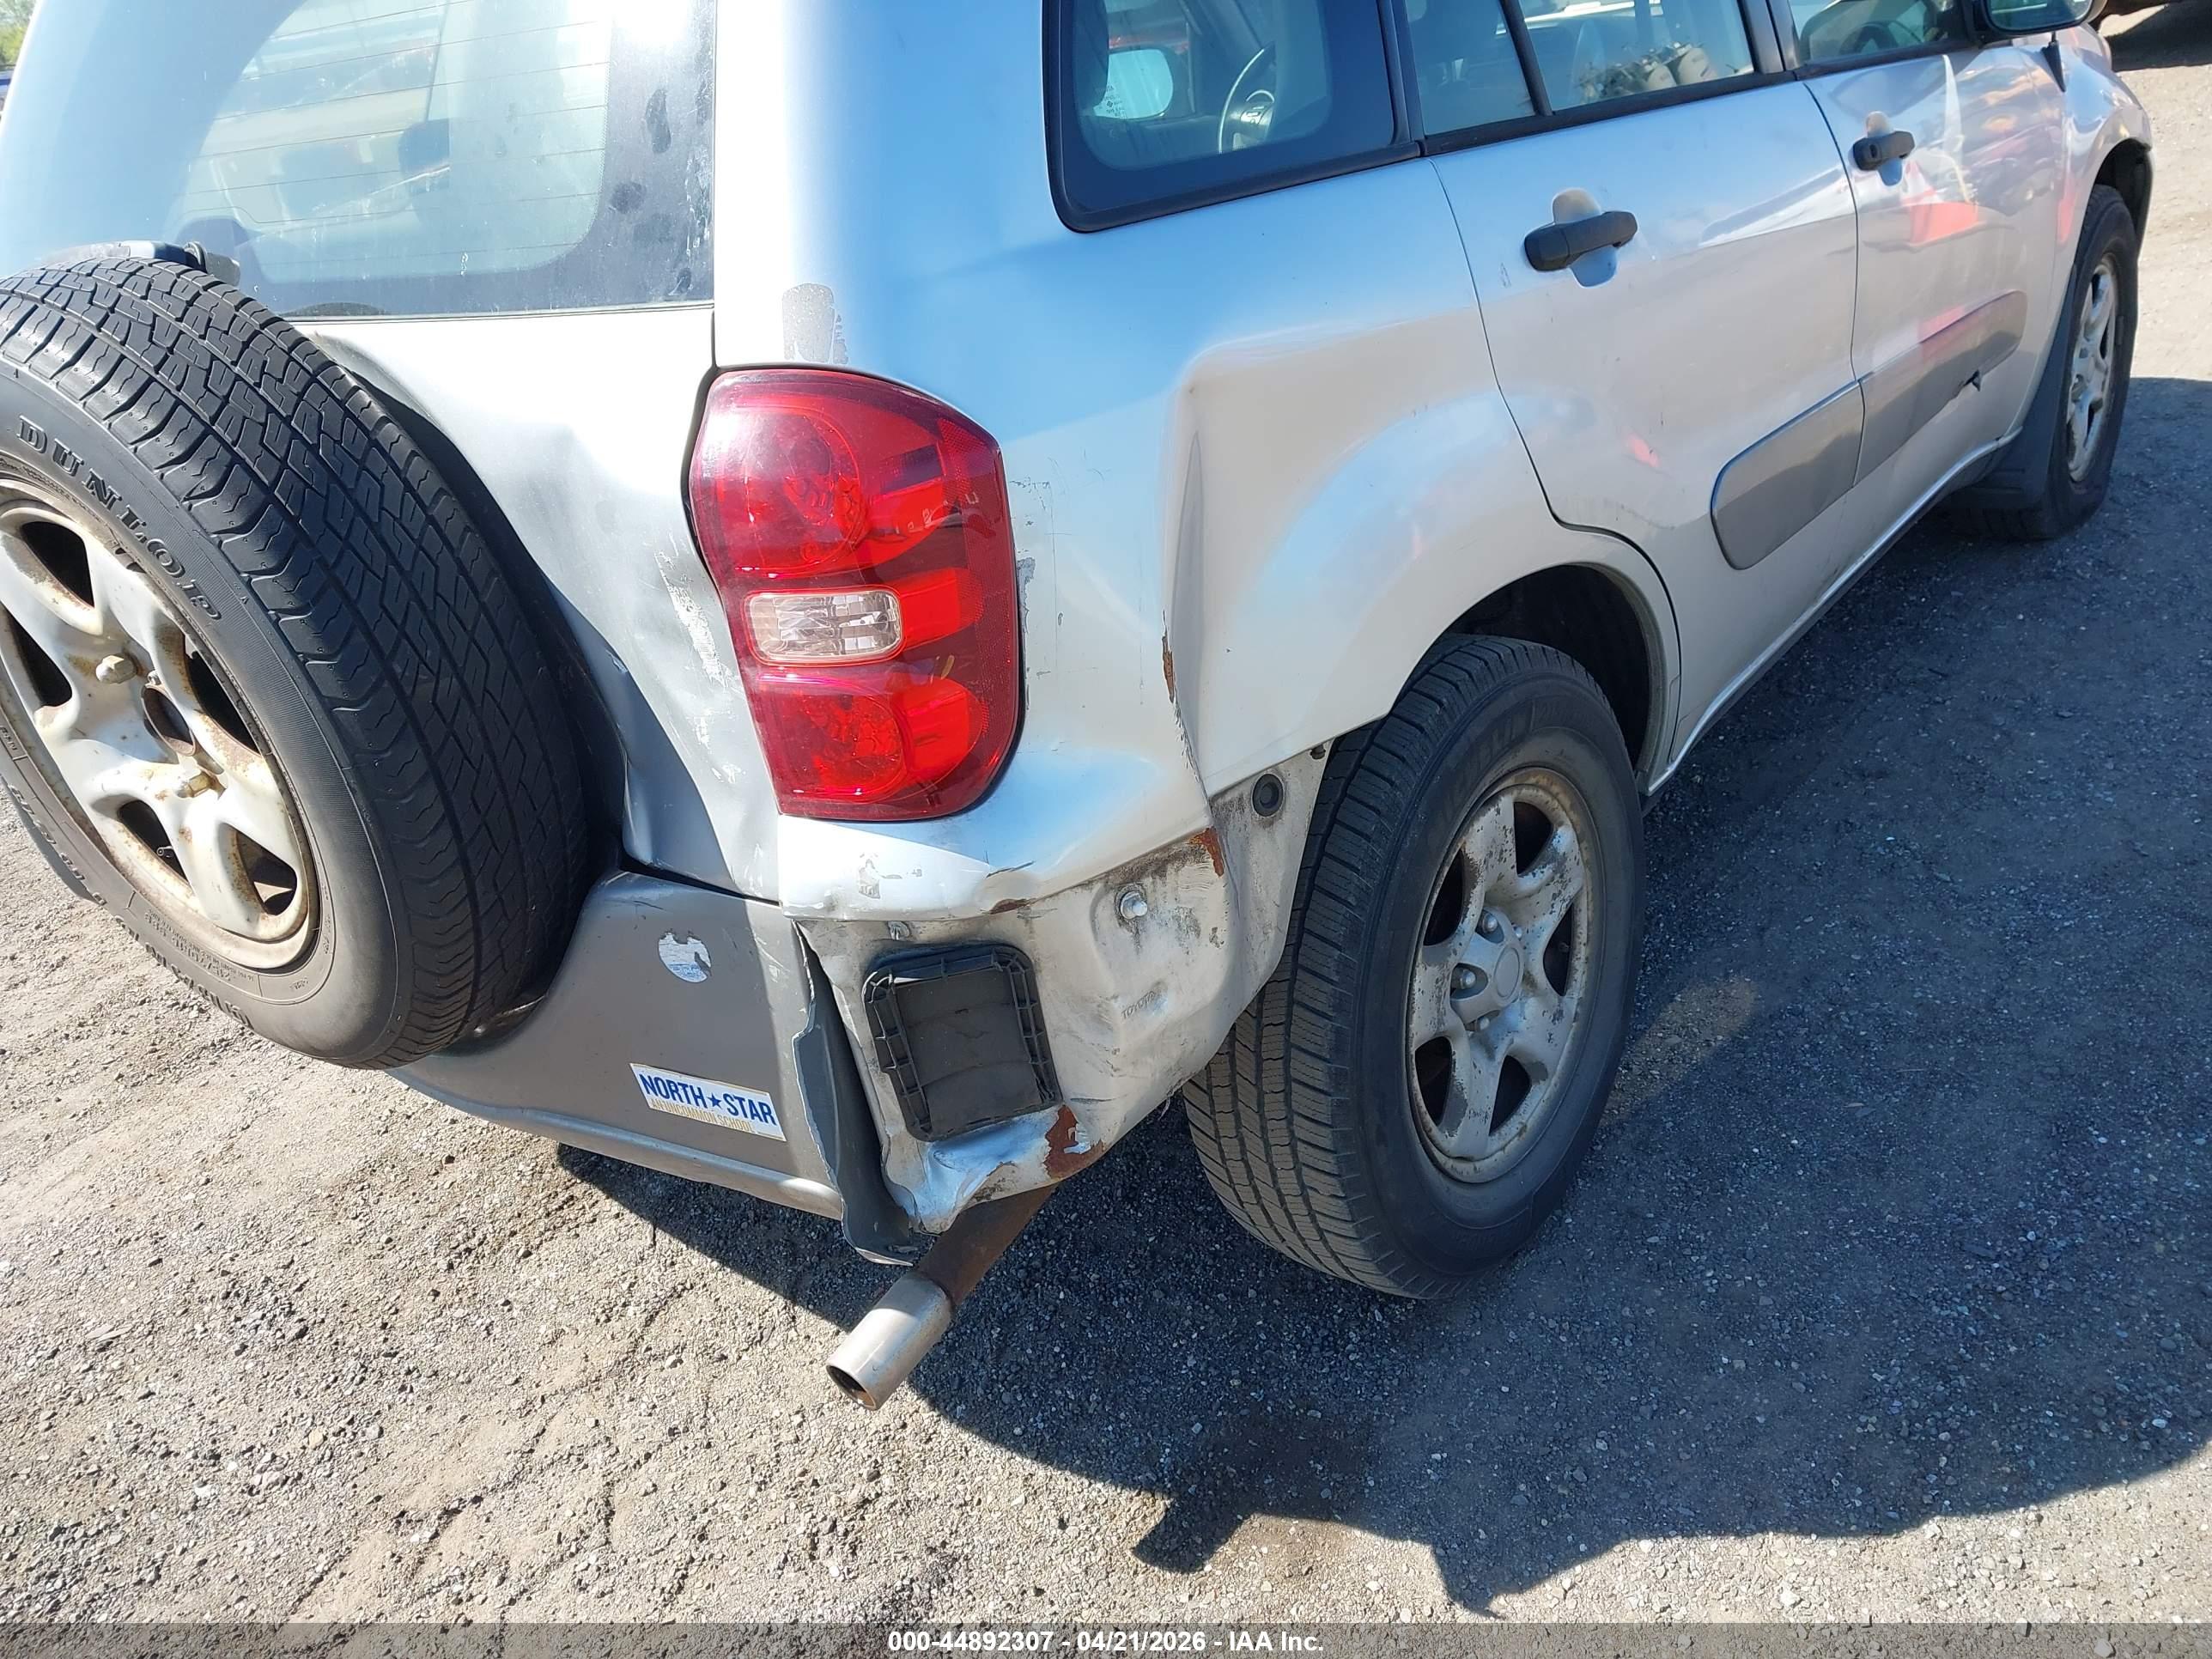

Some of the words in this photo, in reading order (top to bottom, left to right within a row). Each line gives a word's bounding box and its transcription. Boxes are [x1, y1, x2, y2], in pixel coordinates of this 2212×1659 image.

[17, 415, 222, 620] DUNLOP
[639, 1073, 708, 1109] NORTH
[722, 1093, 776, 1126] STAR
[717, 1114, 756, 1133] SCHOOL
